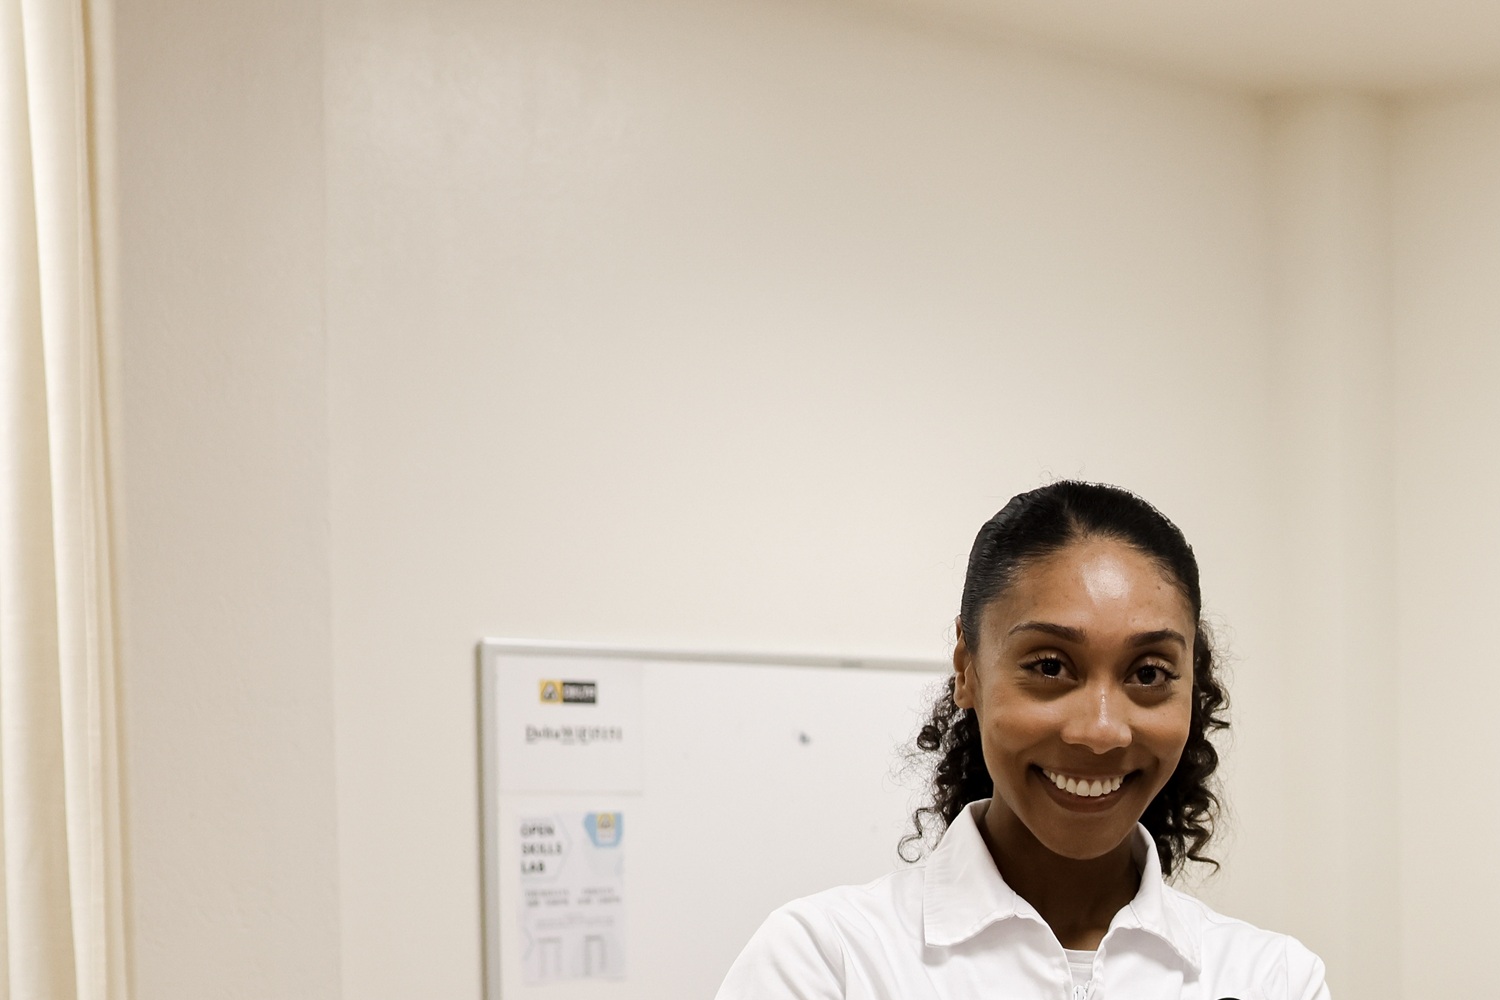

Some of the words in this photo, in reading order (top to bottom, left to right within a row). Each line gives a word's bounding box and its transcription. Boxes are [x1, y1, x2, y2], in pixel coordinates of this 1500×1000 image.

[520, 823, 555, 836] OPEN
[521, 842, 563, 855] SKILLS
[520, 861, 545, 873] LAB
